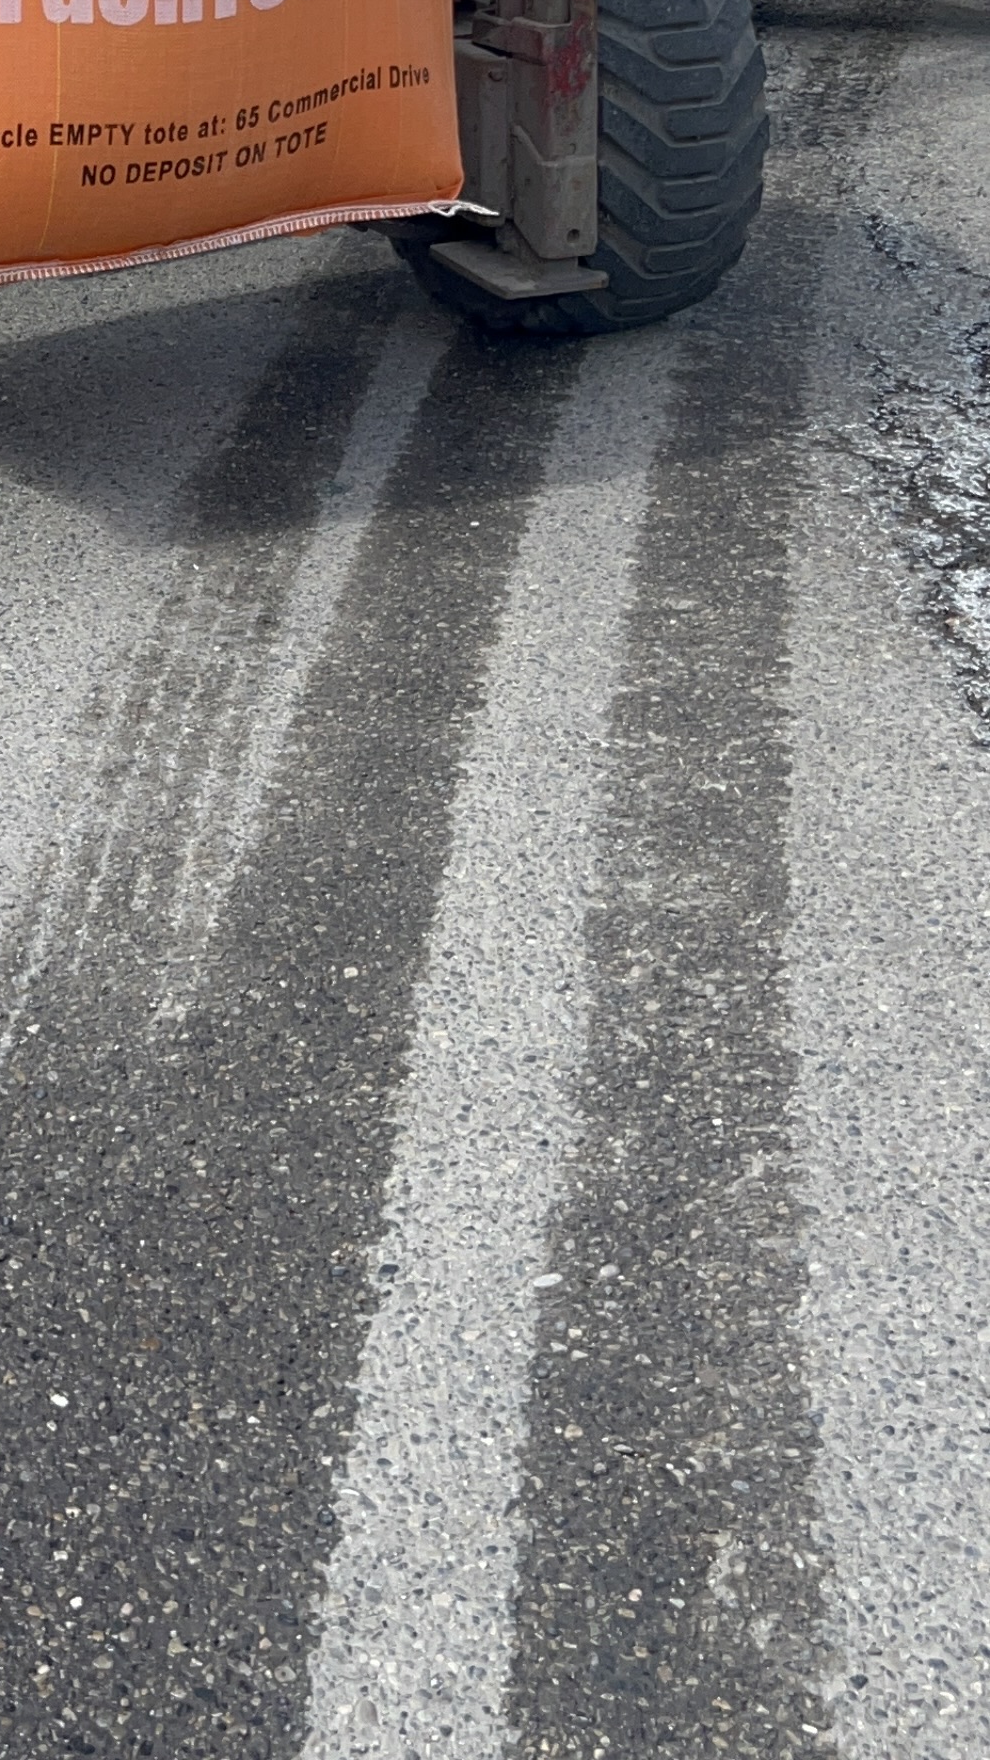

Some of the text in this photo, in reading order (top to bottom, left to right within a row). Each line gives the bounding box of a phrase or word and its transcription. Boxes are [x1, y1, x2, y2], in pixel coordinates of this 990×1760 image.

[49, 123, 136, 146] EMPTY
[144, 122, 188, 145] tote
[197, 115, 226, 139] at:
[235, 105, 260, 131] 65
[268, 66, 382, 123] Commercial
[389, 64, 430, 89] Drive
[81, 121, 328, 187] NO DEPOSIT ON TOTE
